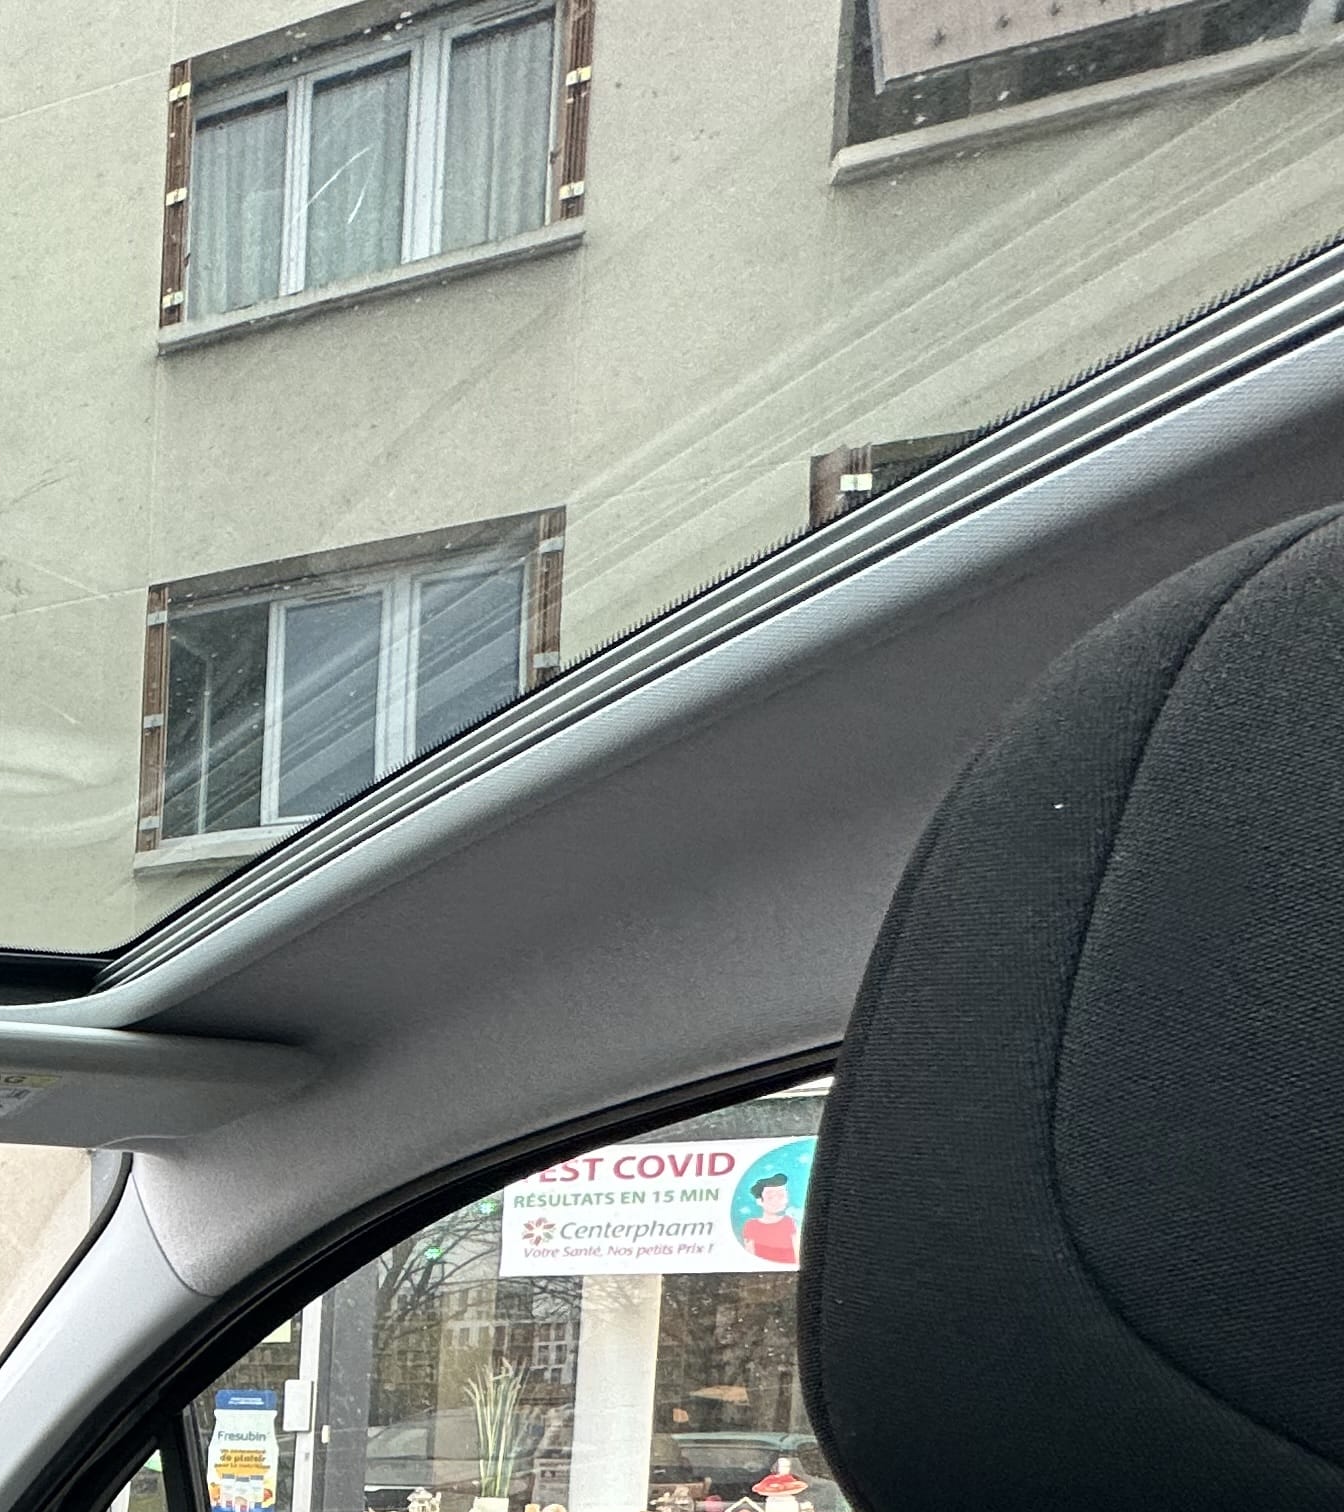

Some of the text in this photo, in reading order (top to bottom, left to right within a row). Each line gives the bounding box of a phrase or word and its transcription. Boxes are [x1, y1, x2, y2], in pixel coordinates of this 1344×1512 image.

[524, 1152, 735, 1183] EST COVID
[513, 1188, 720, 1208] RÉSULTATS EN 15 MIN
[560, 1220, 715, 1243] Centerpharm
[523, 1247, 560, 1258] Votre
[607, 1246, 633, 1257] Nos
[636, 1244, 673, 1259] petits
[677, 1243, 705, 1255] Prix
[217, 1430, 266, 1442] Fresubin
